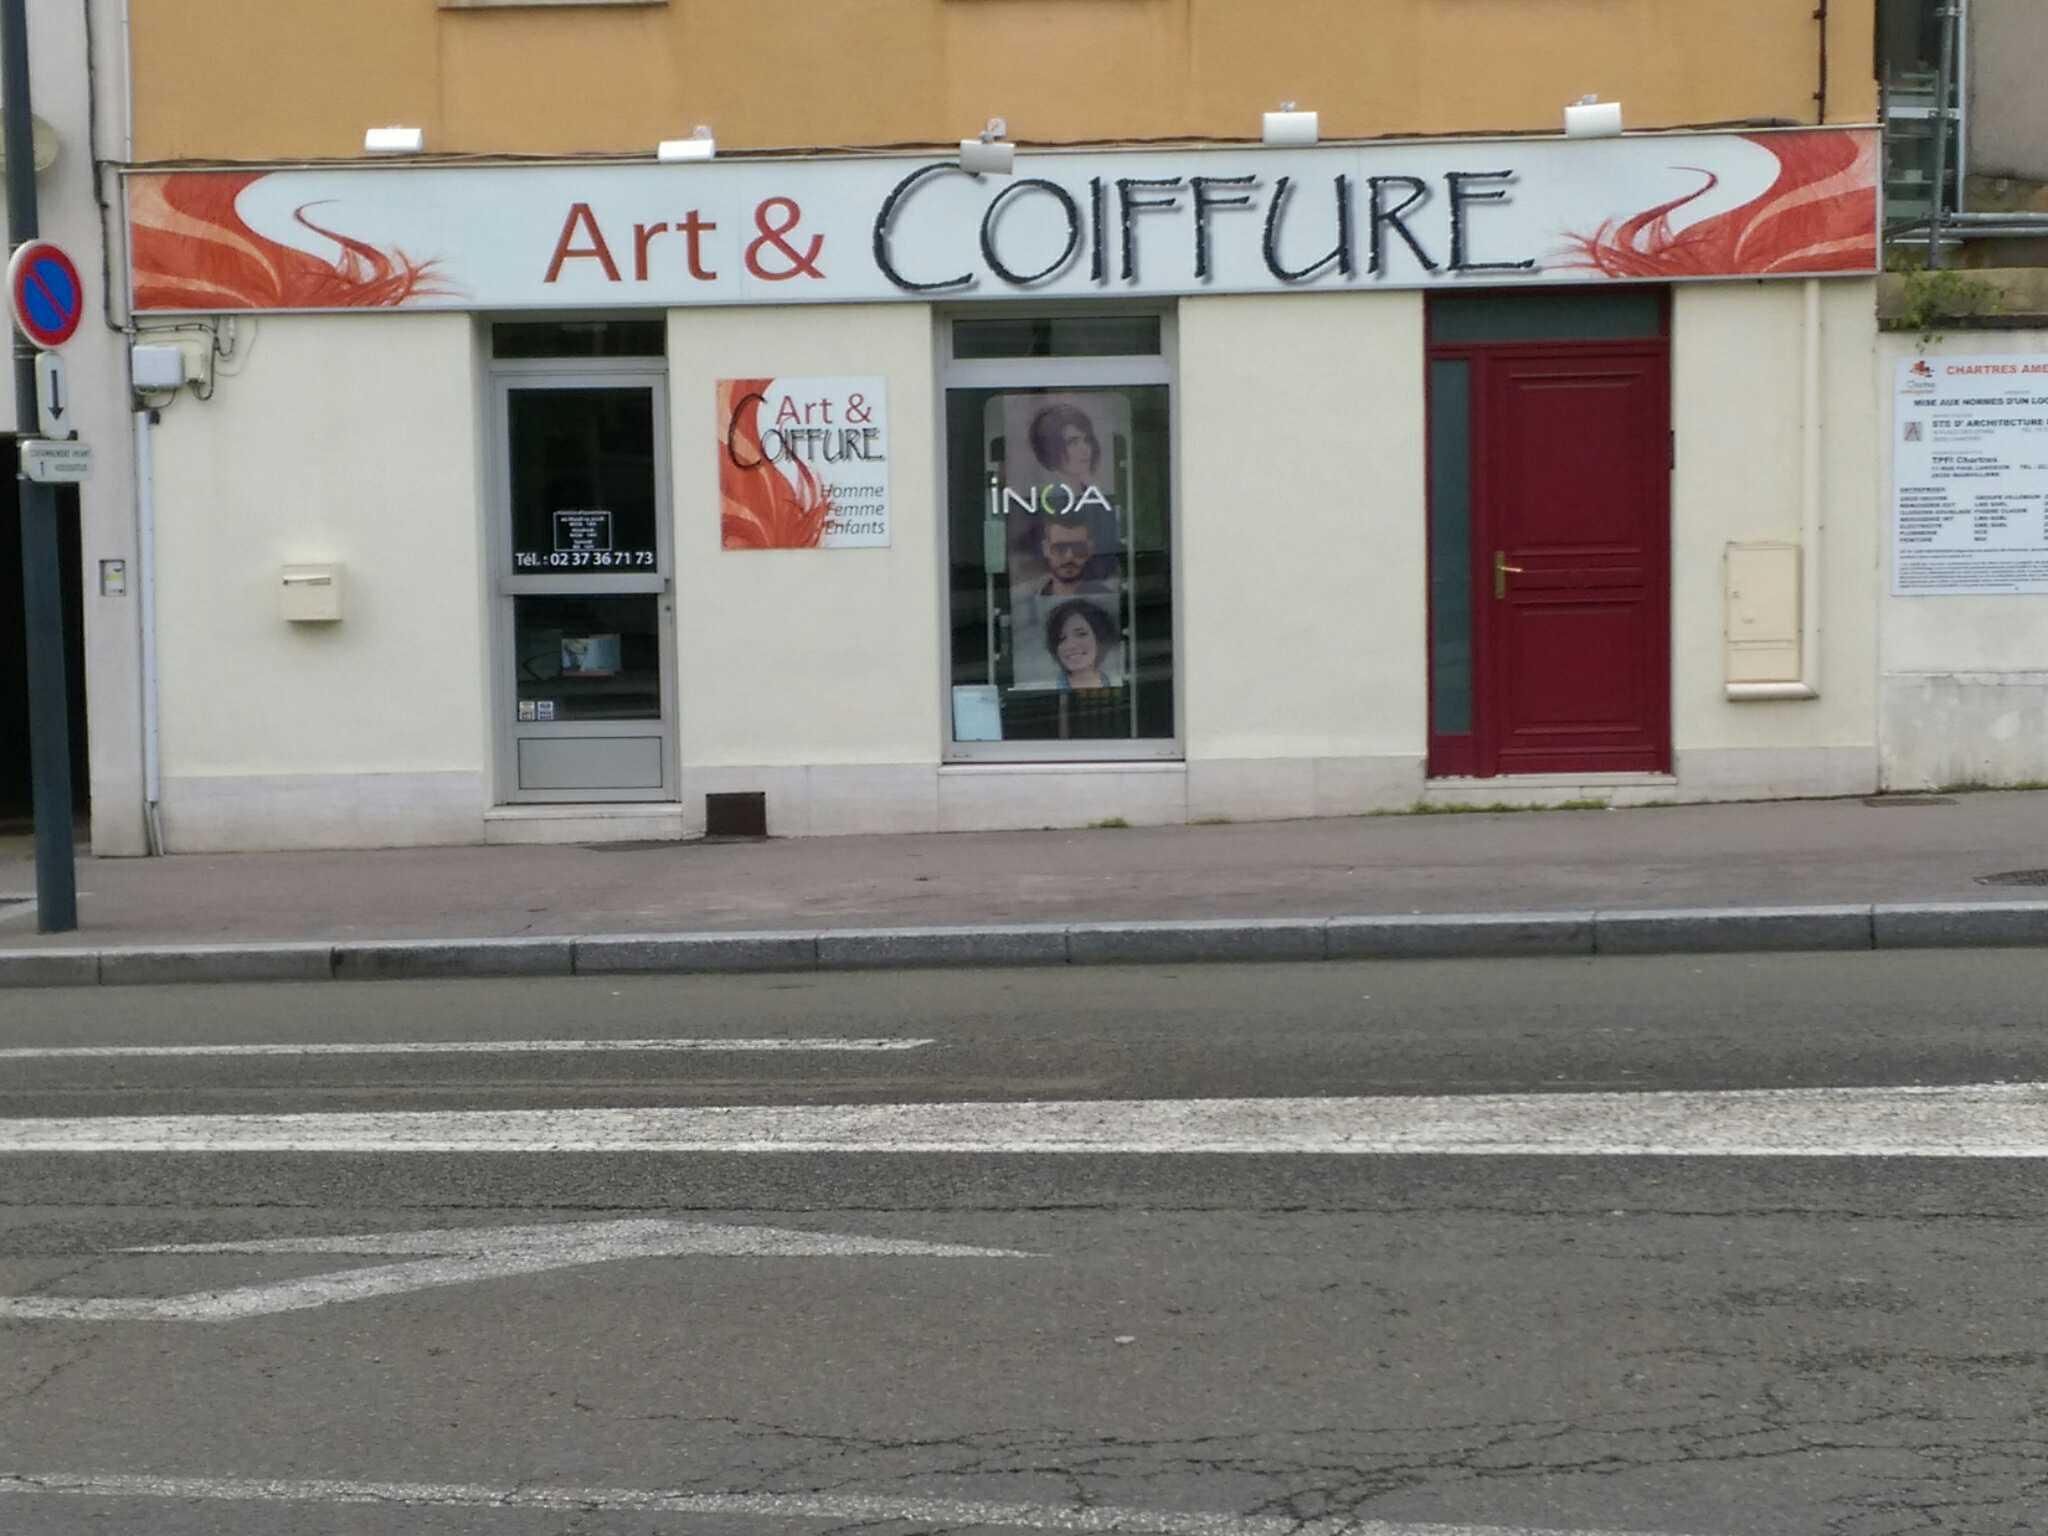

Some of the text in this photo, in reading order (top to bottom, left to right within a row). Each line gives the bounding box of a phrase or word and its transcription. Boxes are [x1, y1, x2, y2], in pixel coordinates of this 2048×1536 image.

[543, 162, 1537, 291] Art & COIFFURE
[1945, 364, 2017, 376] CHARTRES
[775, 392, 873, 425] Art &
[728, 393, 886, 469] COIFFURE
[1966, 418, 2043, 428] ARCHITECTURE
[820, 483, 885, 499] Homme
[825, 501, 885, 517] Femme
[824, 520, 886, 536] Enfants
[549, 552, 569, 567] 02
[571, 552, 590, 566] 37
[592, 552, 612, 566] 36
[614, 551, 631, 566] 71
[635, 551, 654, 565] 73
